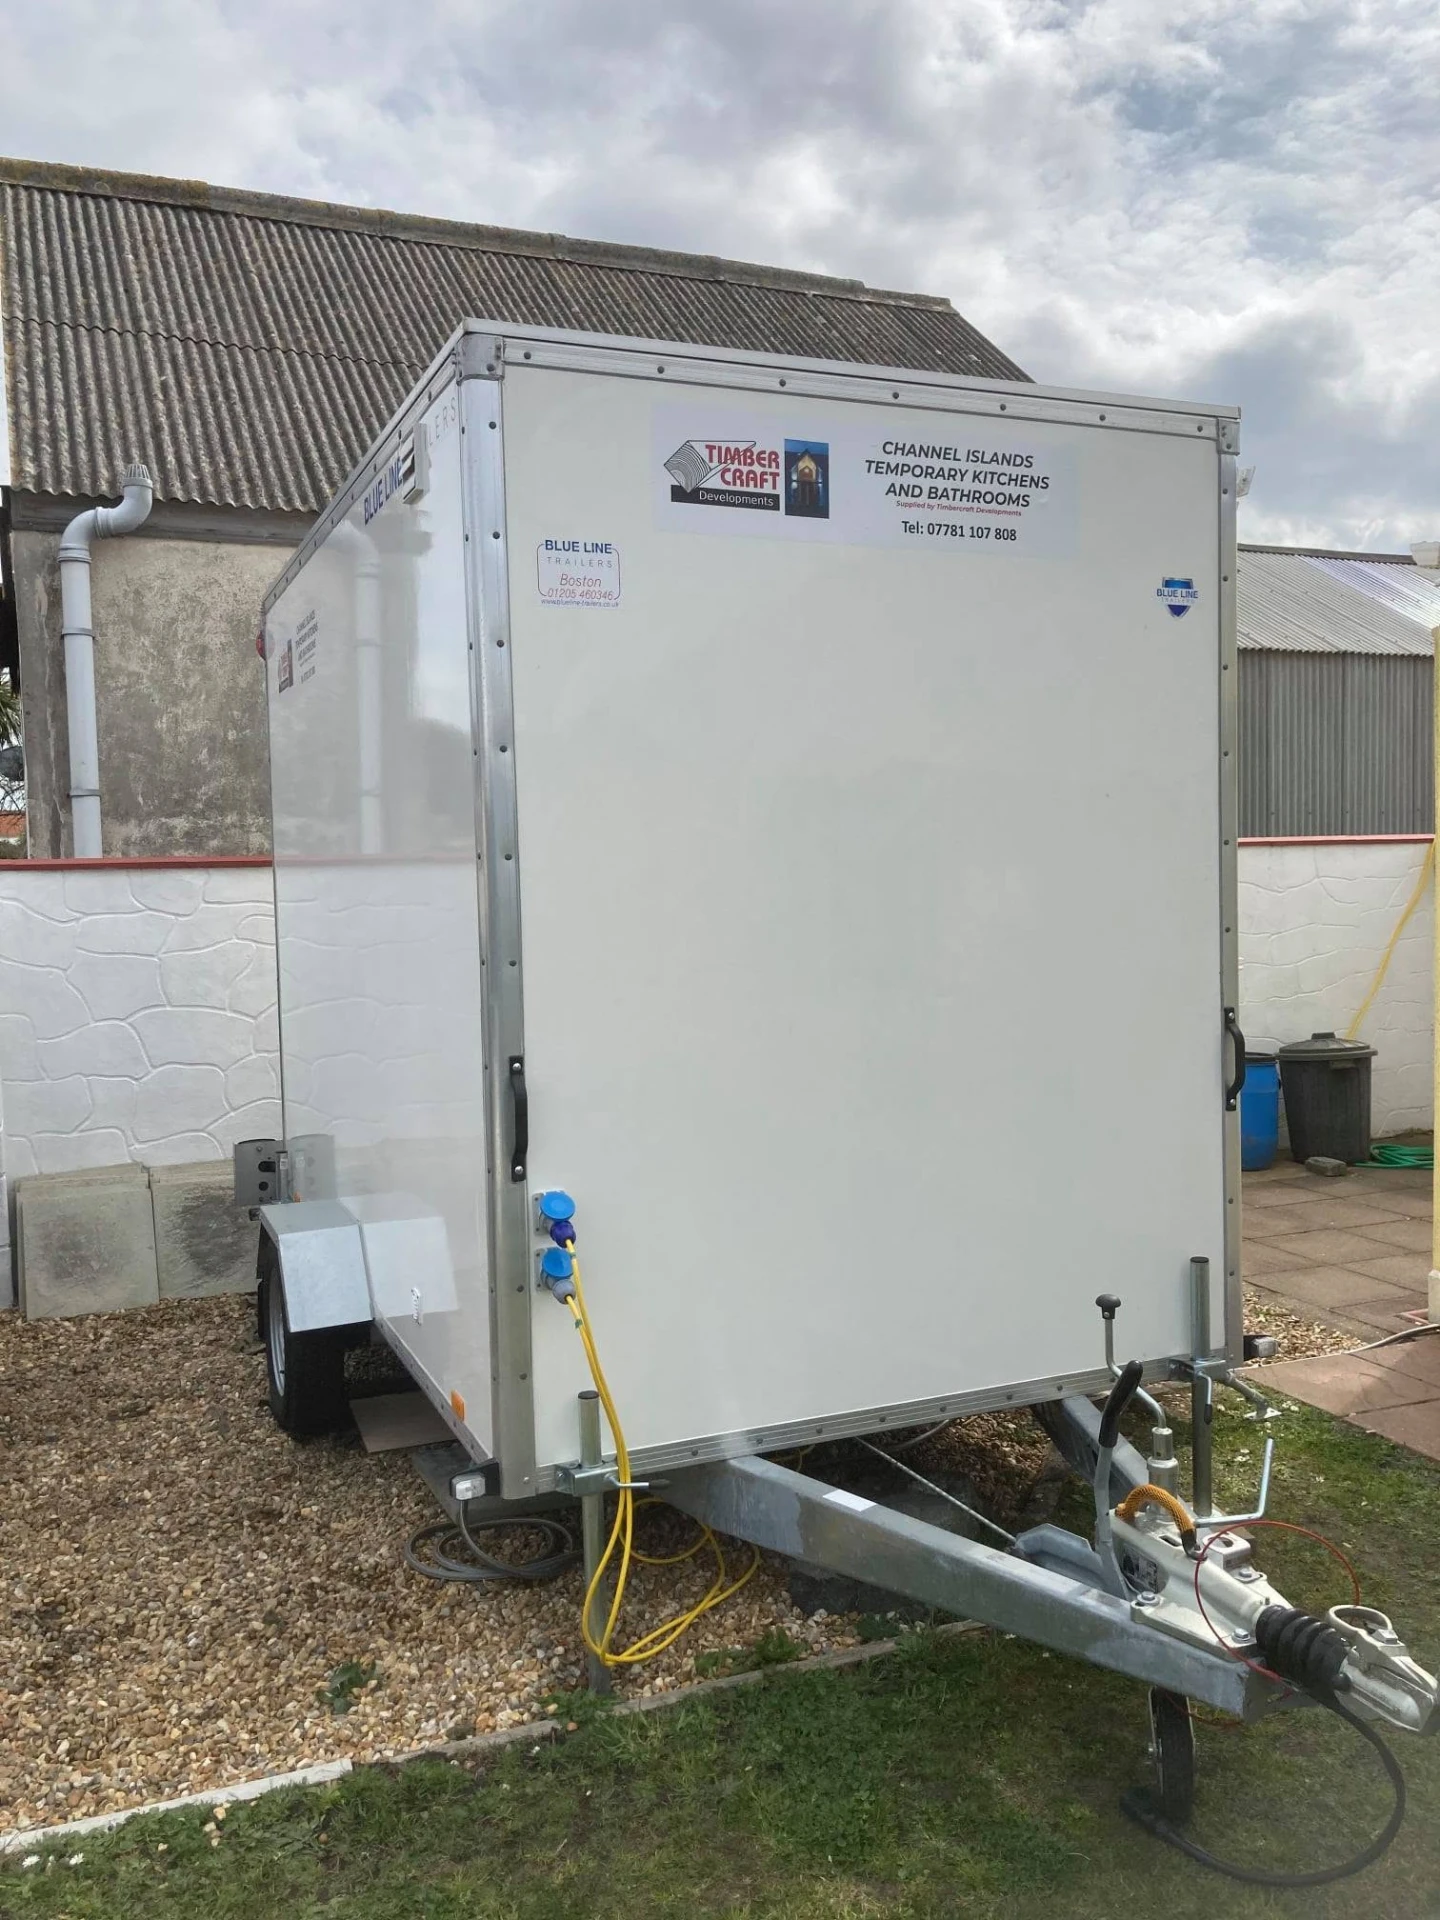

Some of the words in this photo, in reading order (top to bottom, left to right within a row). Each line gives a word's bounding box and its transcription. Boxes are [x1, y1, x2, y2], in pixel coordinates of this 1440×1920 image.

[705, 444, 780, 470] TIMBER
[882, 441, 961, 462] CHANNEL
[965, 449, 1034, 468] ISLANDS
[720, 467, 780, 490] CRAFT
[865, 460, 969, 483] TEMPORARY
[971, 470, 1050, 490] KITCHENS
[363, 478, 384, 526] BLUE
[384, 455, 403, 502] LINE
[699, 490, 774, 507] Developments
[885, 482, 923, 499] AND
[927, 486, 1031, 508] BATHROOMS
[896, 500, 926, 509] Supplied
[926, 502, 936, 511] by
[936, 503, 975, 513] Timbercraft
[975, 507, 1022, 517] Developments
[901, 520, 924, 535] Tel:
[927, 522, 965, 538] 07781
[969, 526, 991, 539] 107
[994, 528, 1017, 541] 808
[545, 540, 579, 552] BLUE
[584, 542, 613, 554] LINE
[547, 556, 613, 568] TRAILERS
[560, 573, 602, 587] Boston
[547, 588, 576, 598] 01205
[579, 589, 613, 600] 460346
[1157, 589, 1178, 597] BLUE
[1181, 590, 1198, 598] LINE
